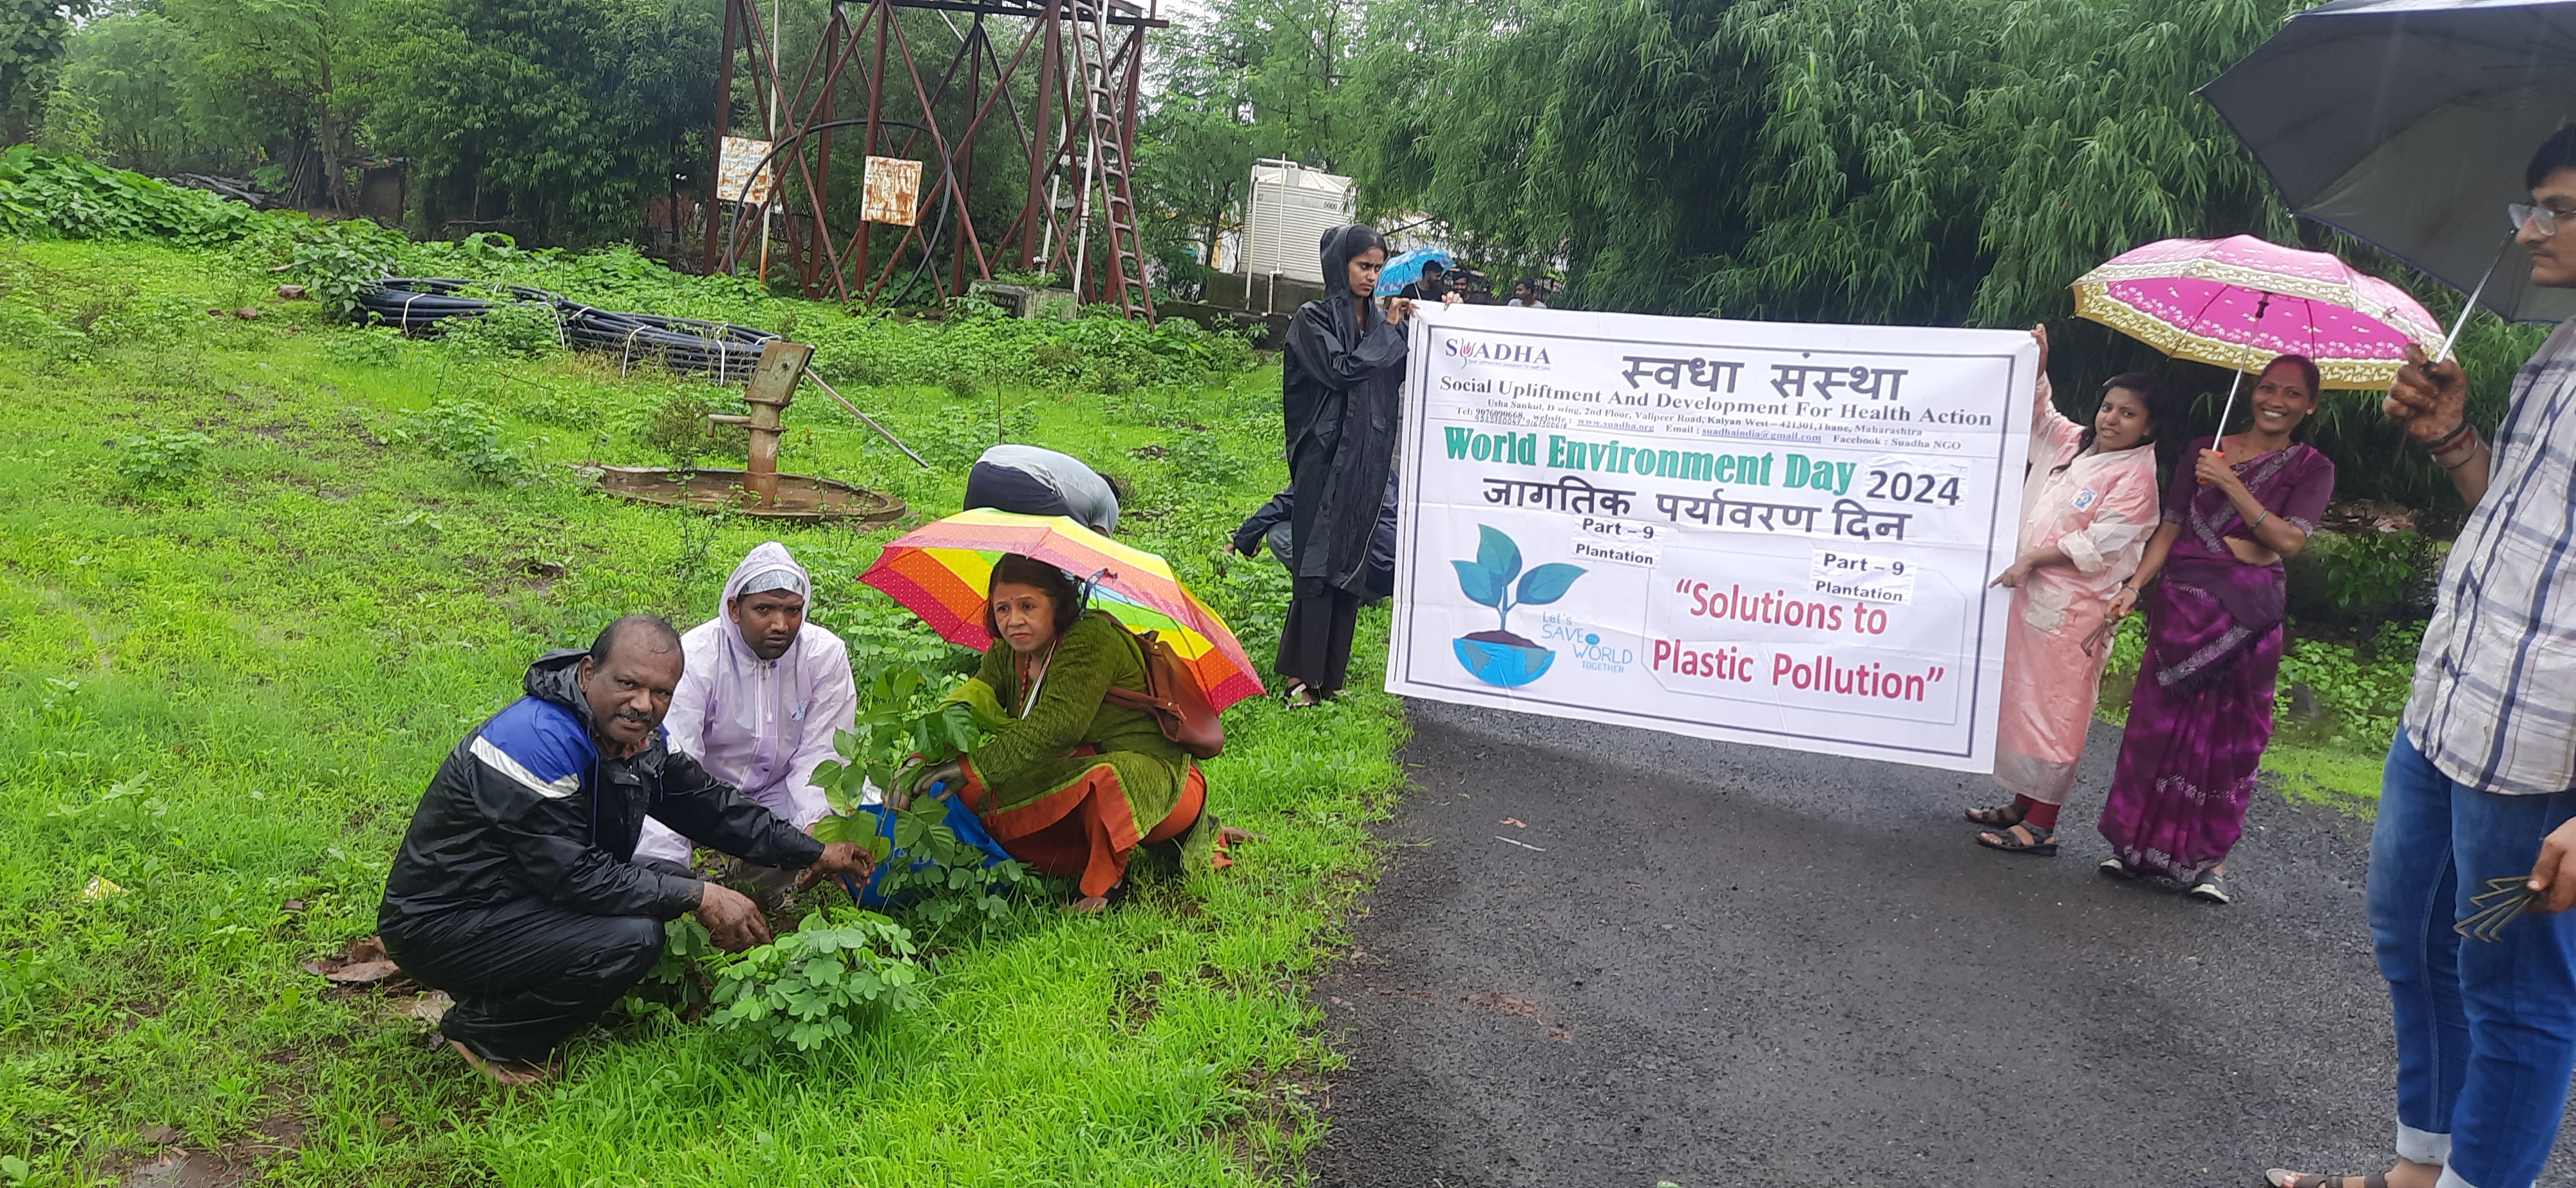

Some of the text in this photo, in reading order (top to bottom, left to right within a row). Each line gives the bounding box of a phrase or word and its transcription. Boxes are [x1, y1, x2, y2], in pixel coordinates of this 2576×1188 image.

[1622, 352, 1908, 401] स्वधा संस्था
[1440, 376, 1992, 426] Social Upliftment And Development For Health Action
[1456, 407, 1473, 416] Tel:
[1665, 425, 1694, 434] Email
[1702, 428, 1821, 444] suadhaindia@gmail.com
[1833, 434, 1881, 445] Facebook
[1891, 437, 1929, 448] Suadha
[1933, 440, 1961, 450] NGO
[1488, 399, 1508, 408] Usha
[1511, 400, 1544, 411] Sankul,
[1558, 406, 1582, 415] wing,
[1605, 409, 1631, 419] Floor,
[1677, 414, 1705, 424] Road,
[1708, 416, 1741, 426] Kalyan
[1745, 418, 1768, 426] West
[1855, 425, 1922, 436] Maharashtra
[1444, 426, 1960, 506] World Environment Day 2024
[1482, 475, 1913, 541] जागतिक पर्यावरण दिन
[1582, 517, 1622, 536] Part
[1643, 526, 1654, 539] 9
[1575, 544, 1653, 565] Plantation
[1823, 552, 1868, 571] Part
[1891, 561, 1904, 575] 9
[1815, 580, 1903, 602] Plantation
[1543, 611, 1572, 625] Let's
[1854, 602, 1887, 635] to
[1541, 624, 1584, 643] SAVE
[1573, 643, 1633, 664] WORLD
[1582, 660, 1624, 673] TOGETHER
[1653, 638, 1754, 682] Plastic
